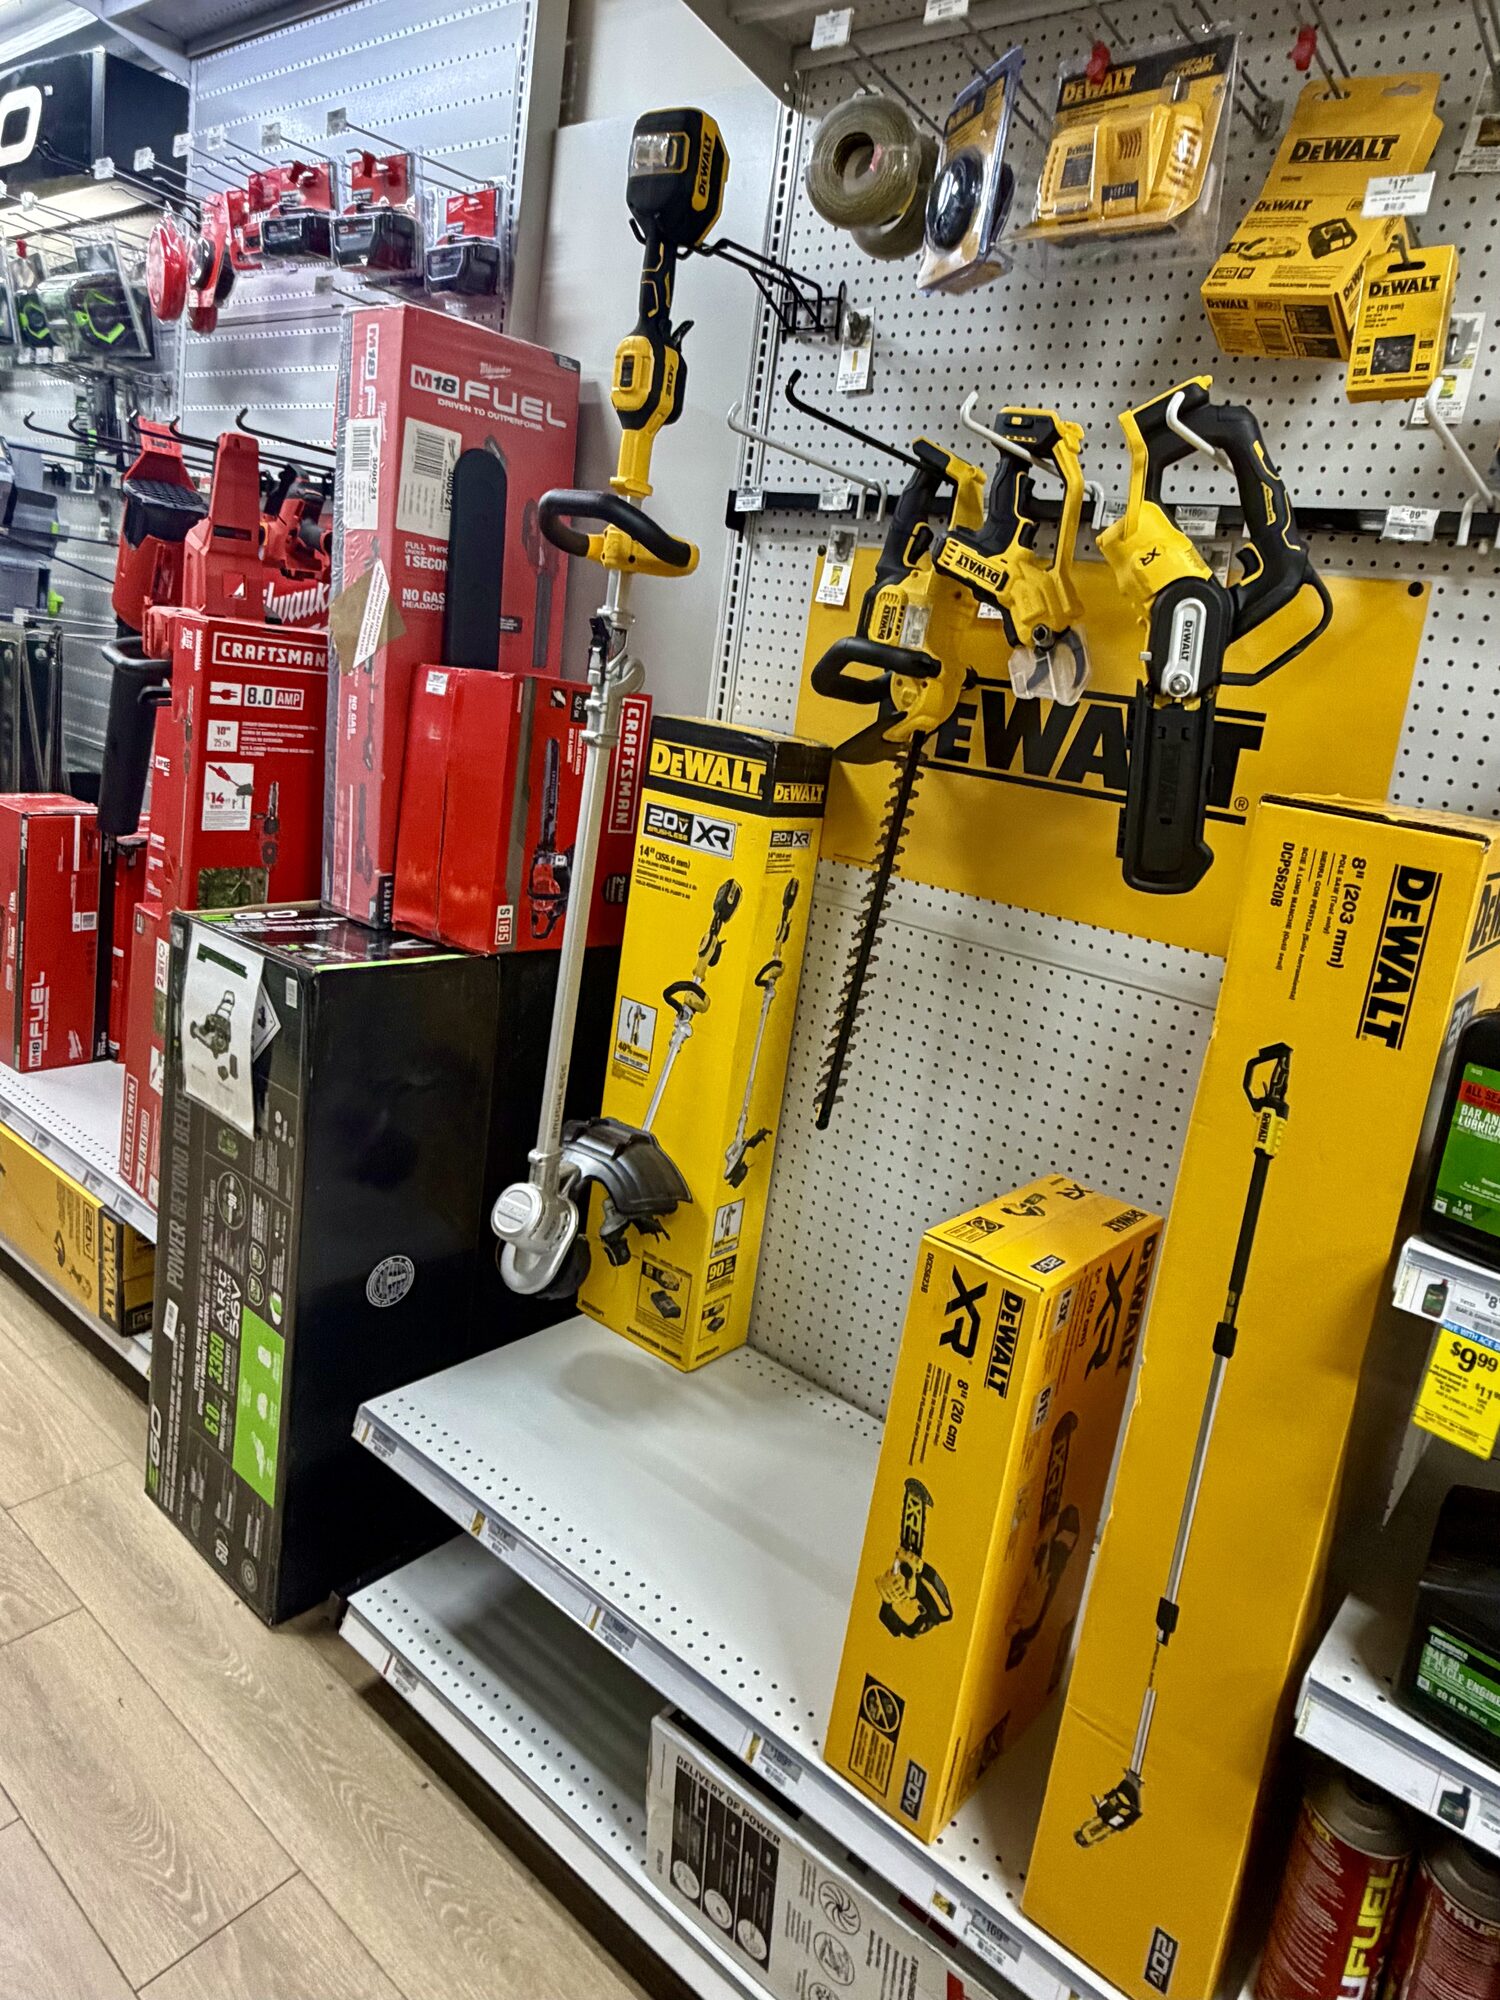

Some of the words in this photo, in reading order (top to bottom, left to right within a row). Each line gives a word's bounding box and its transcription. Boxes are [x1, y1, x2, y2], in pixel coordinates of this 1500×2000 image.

[698, 131, 715, 198] DEWALT
[1288, 134, 1400, 165] DEWALT
[1254, 199, 1314, 212] DEWALT
[1369, 275, 1441, 299] DEWALT
[1206, 298, 1249, 310] DEWALT
[414, 370, 457, 394] M18
[464, 380, 567, 429] FUEL
[438, 398, 471, 413] DRIVEN
[474, 407, 485, 417] TO
[405, 541, 426, 551] FULL
[1139, 547, 1161, 566] XR
[402, 588, 420, 601] NO
[422, 590, 446, 604] GAS
[877, 604, 892, 640] DEWALT
[221, 640, 327, 668] CRAFTSMAN
[1181, 619, 1194, 662] DEWALT
[247, 686, 274, 705] 8.0
[276, 691, 301, 707] AMP
[616, 706, 641, 826] CRAFTSMAN
[651, 743, 767, 796] DEWALT
[774, 783, 824, 802] DEWALT
[694, 820, 731, 851] XR
[794, 831, 810, 845] XR
[1270, 841, 1296, 908] DCPS620B
[1338, 854, 1347, 874] POLE
[1351, 856, 1367, 879] 8"
[1294, 874, 1303, 894] LONG
[1312, 881, 1322, 897] CON
[1334, 877, 1342, 894] SAW
[1339, 883, 1362, 926] (203
[1326, 929, 1349, 970] mm)
[1362, 865, 1438, 1050] DEWALT
[29, 971, 50, 1037] FUEL
[1465, 1084, 1482, 1098] ALL
[1461, 1104, 1482, 1121] BAR
[170, 1154, 190, 1219] BEYOND
[168, 1219, 188, 1292] POWER
[708, 1261, 725, 1280] 90
[228, 1280, 241, 1340] 56V
[939, 1265, 989, 1359] XR
[208, 1331, 225, 1385] 3360
[984, 1289, 1025, 1399] DEWALT
[957, 1378, 970, 1399] 8"
[950, 1398, 966, 1425] (20
[943, 1424, 959, 1453] cm)
[676, 1755, 724, 1798] DELIVERY
[726, 1796, 740, 1811] OF
[742, 1808, 781, 1846] POWER
[904, 1766, 925, 1817] 20V
[1148, 1937, 1176, 1986] 20V
